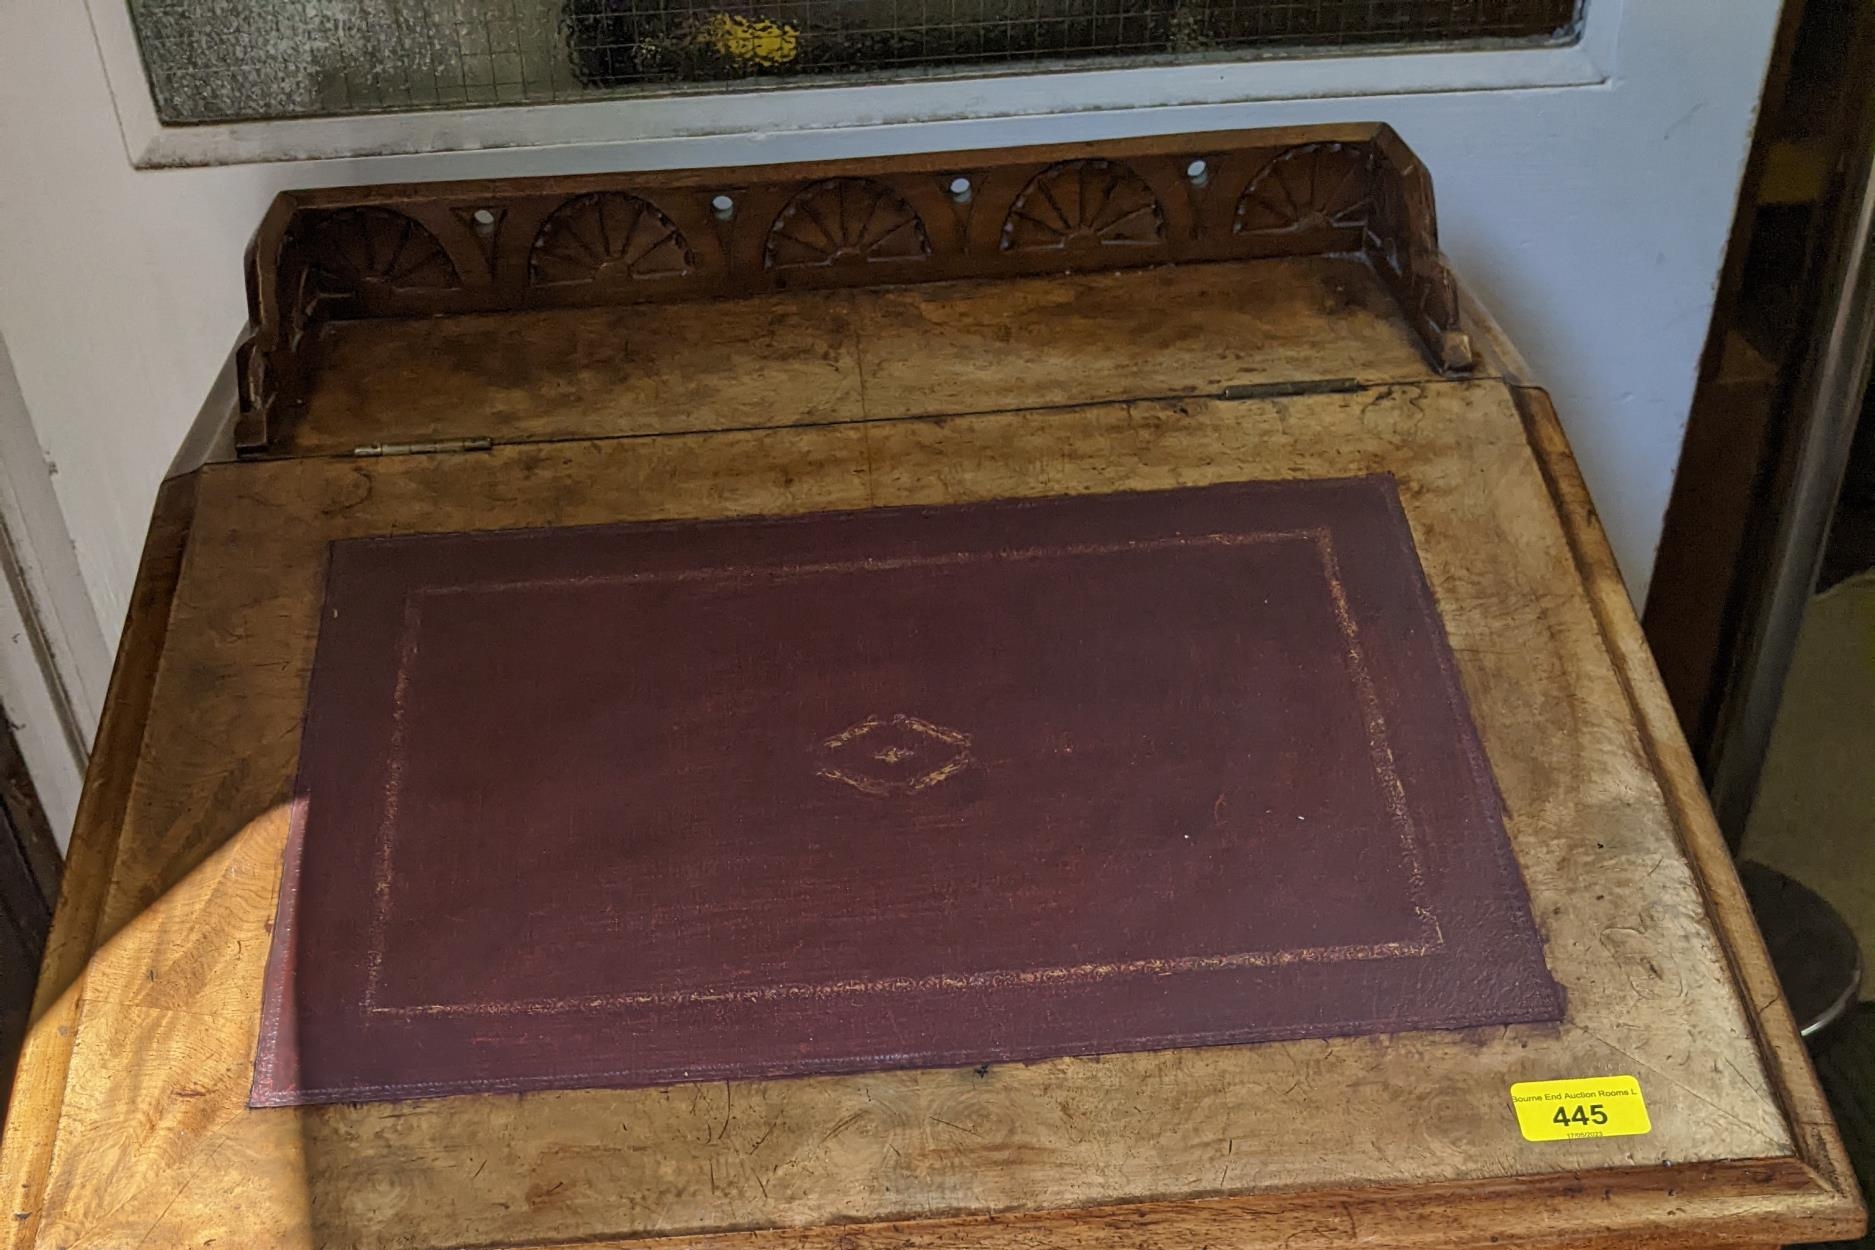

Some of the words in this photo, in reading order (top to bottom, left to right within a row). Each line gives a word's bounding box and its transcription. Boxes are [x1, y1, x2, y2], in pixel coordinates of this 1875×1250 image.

[1545, 1093, 1562, 1101] End
[1564, 1091, 1596, 1100] Auction
[1599, 1089, 1629, 1097] Rooms
[1553, 1104, 1608, 1127] 445
